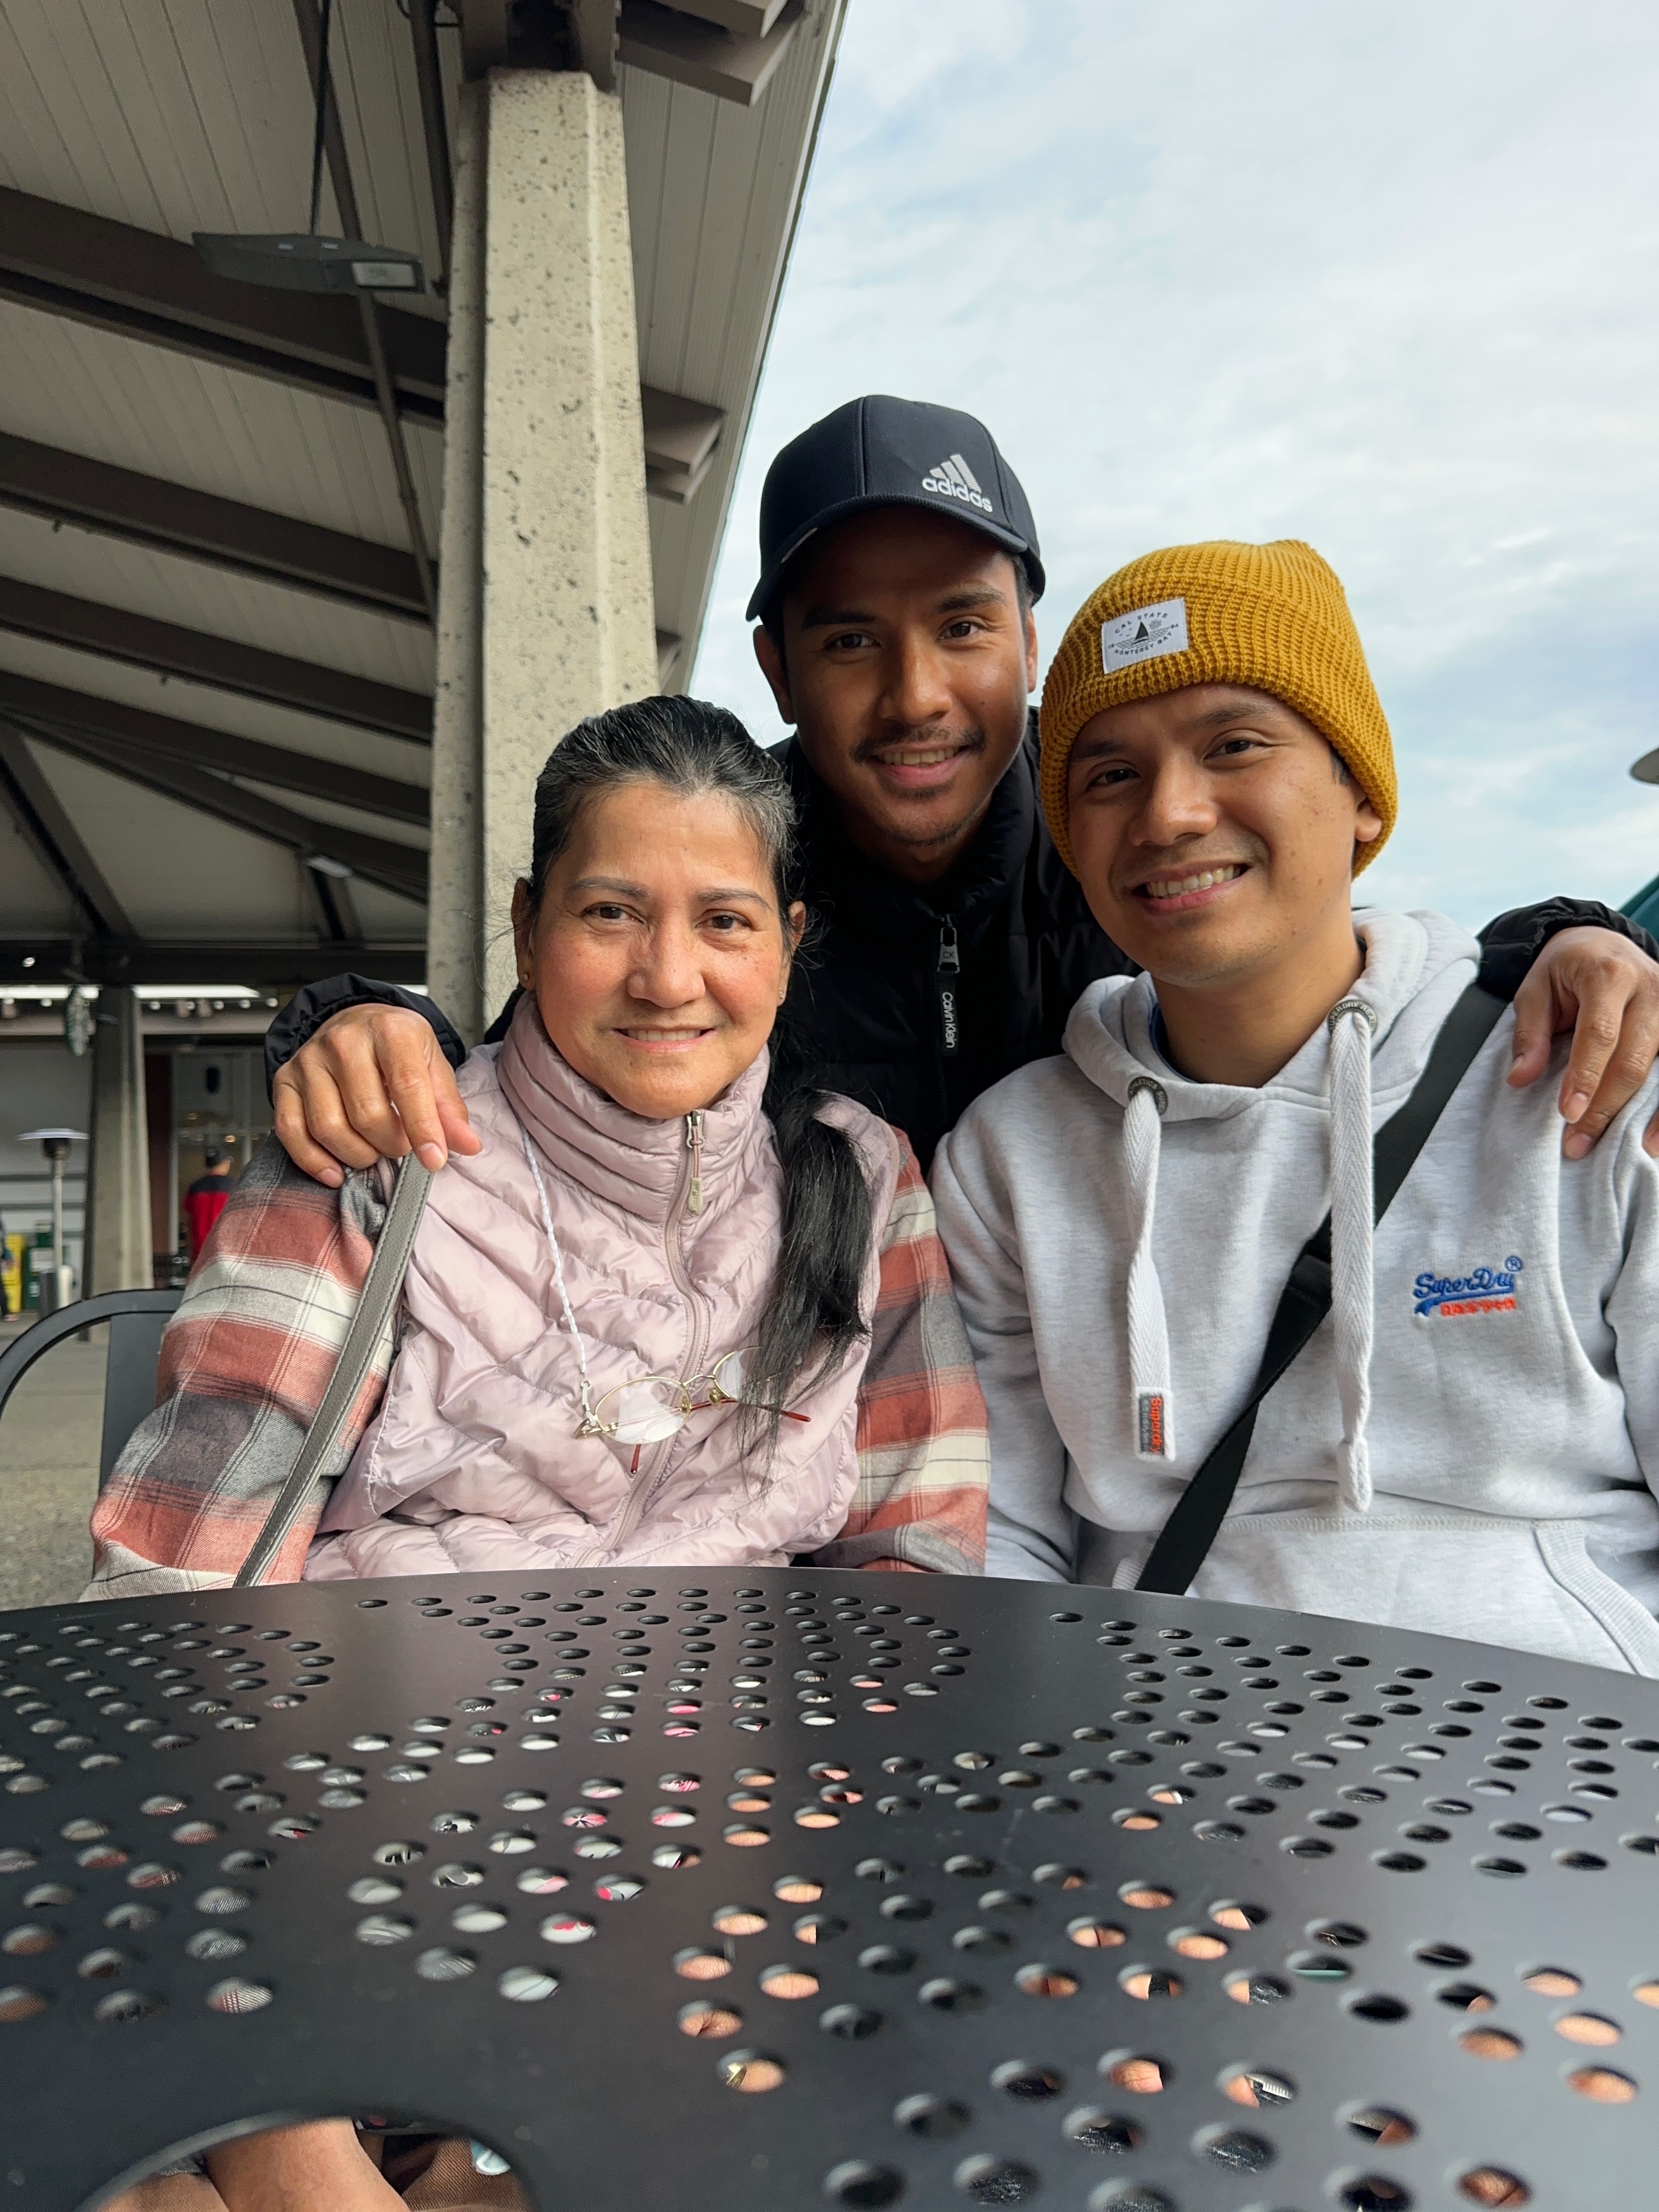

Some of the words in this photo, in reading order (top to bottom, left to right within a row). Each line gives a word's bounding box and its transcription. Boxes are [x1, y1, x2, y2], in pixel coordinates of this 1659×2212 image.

[922, 478, 993, 512] adidas
[1115, 620, 1132, 634] CAL
[1137, 612, 1168, 620] STATE
[1113, 644, 1154, 655] MONTEREY
[1157, 632, 1172, 645] BAY
